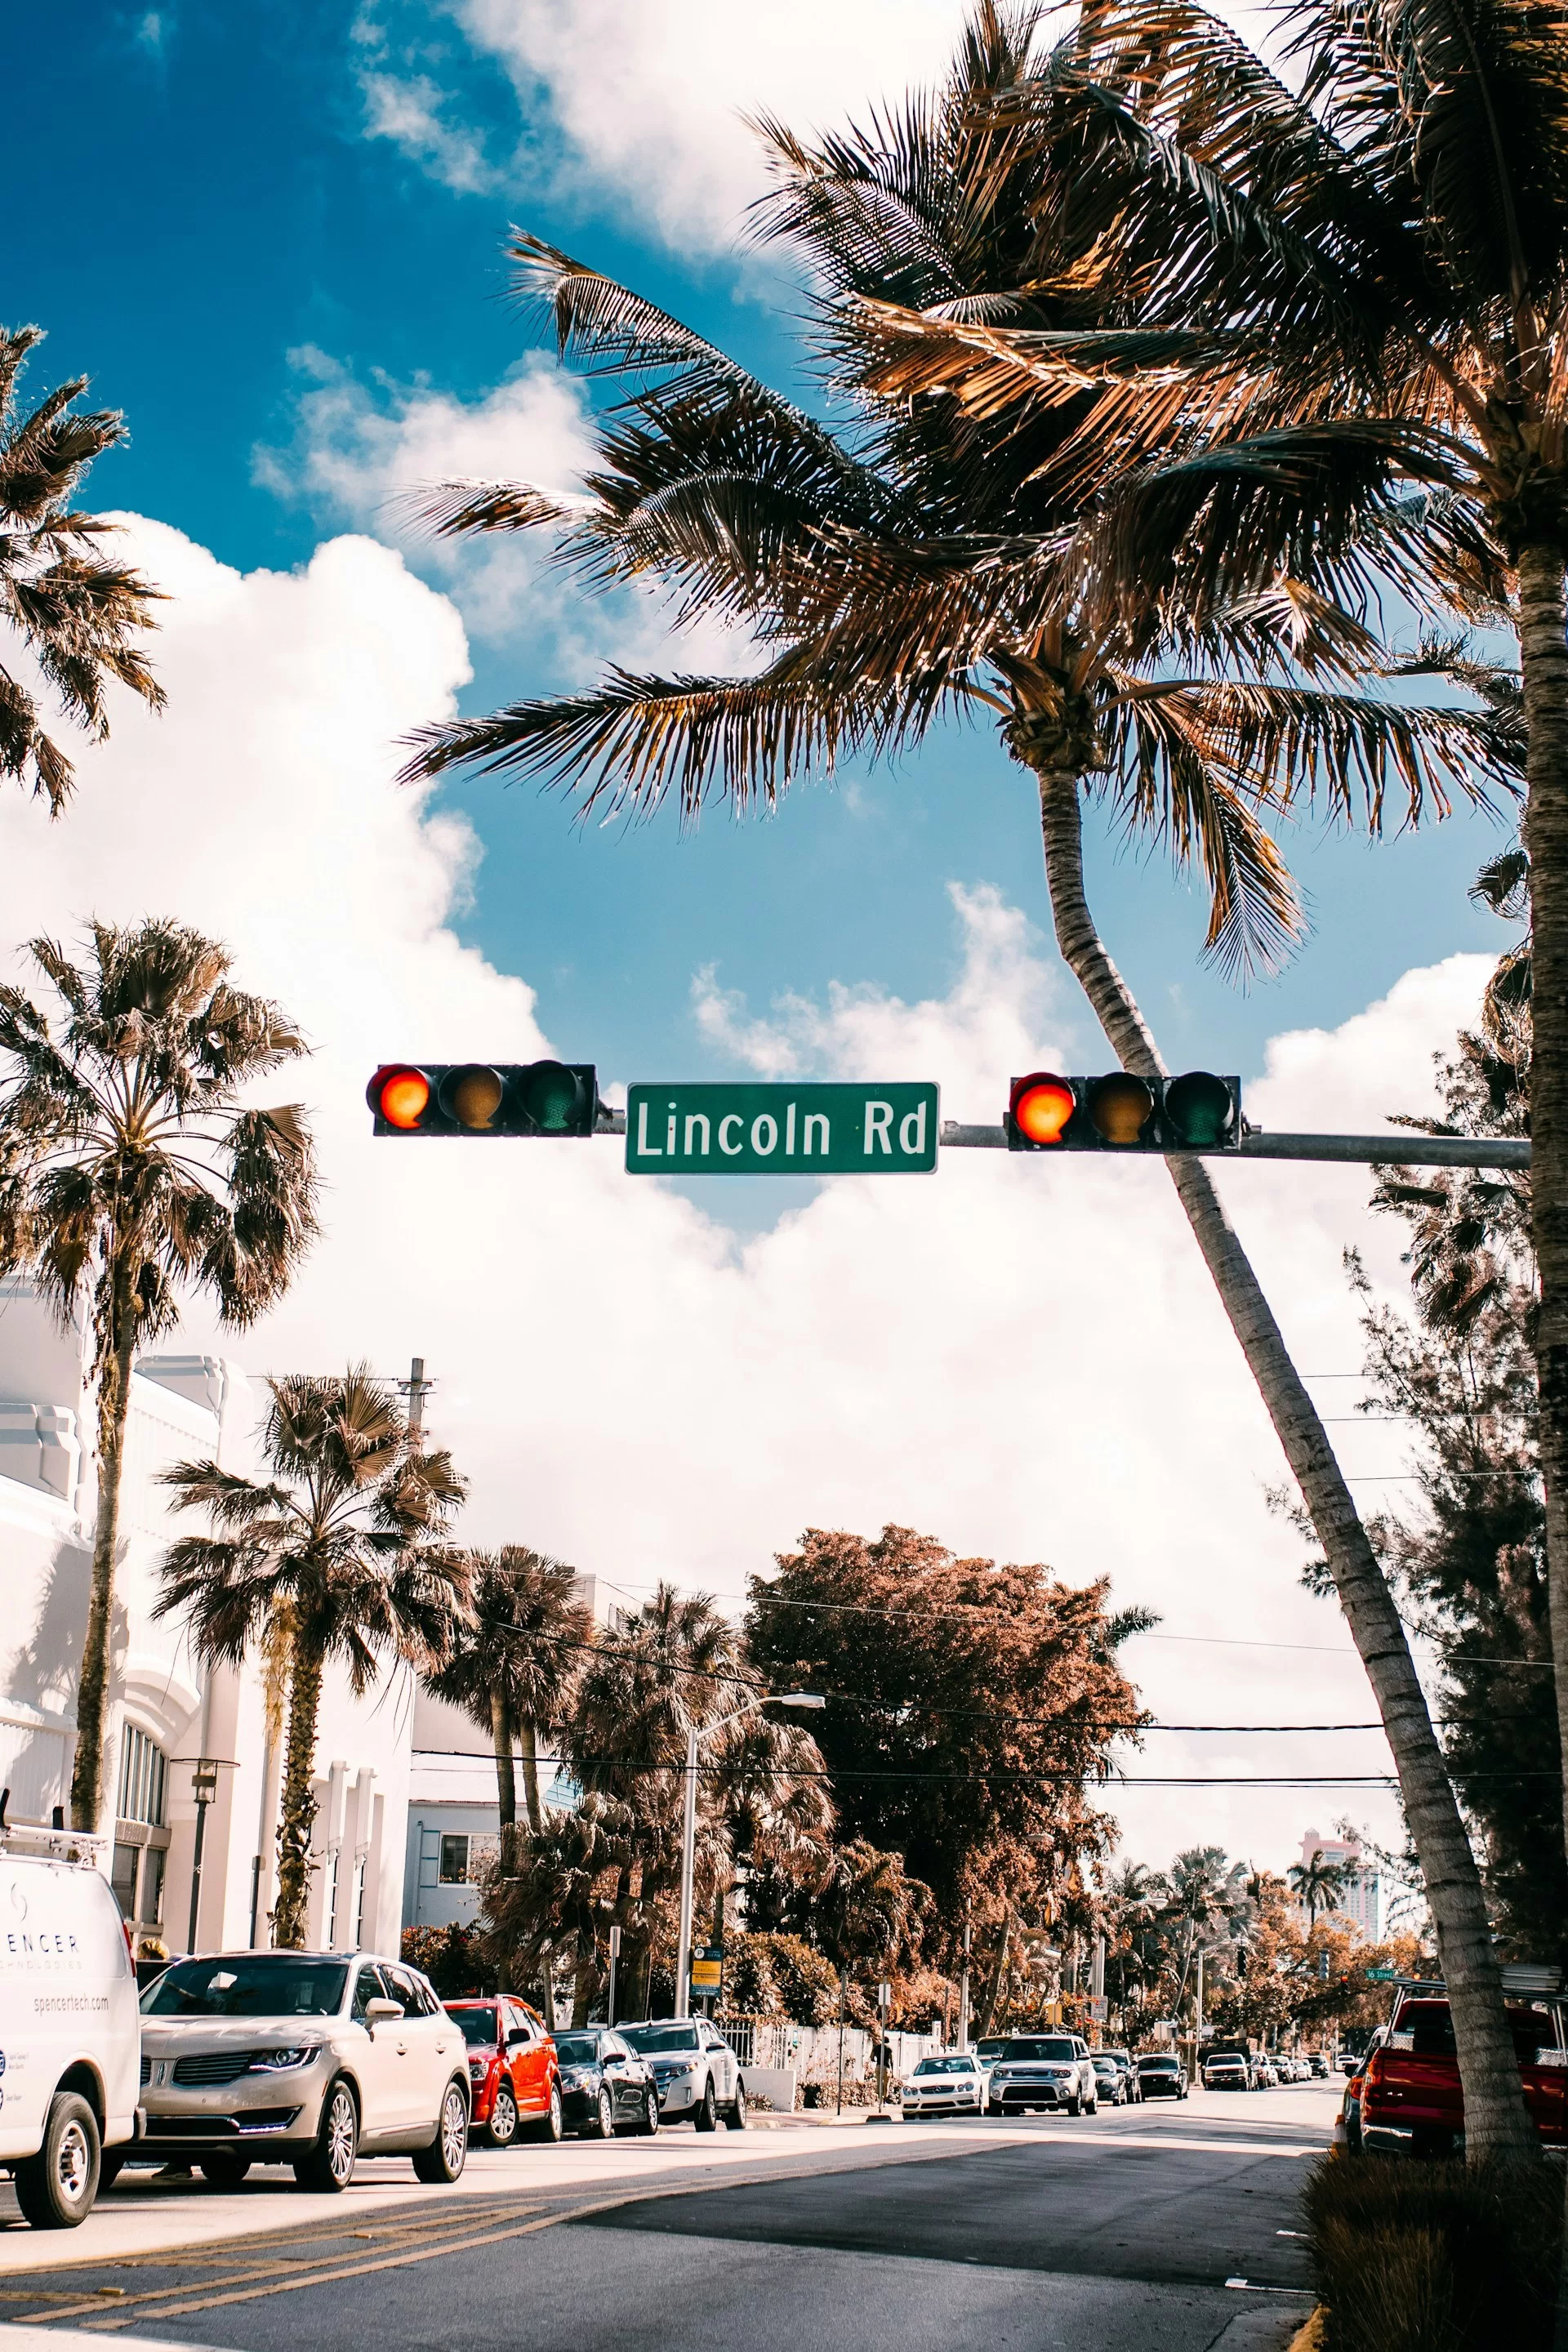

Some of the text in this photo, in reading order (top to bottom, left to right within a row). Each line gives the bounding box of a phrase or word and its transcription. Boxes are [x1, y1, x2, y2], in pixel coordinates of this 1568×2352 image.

[637, 1100, 927, 1156] Lincoln Rd
[1368, 1970, 1374, 1978] 16
[33, 1993, 109, 2017] spencertech.com
